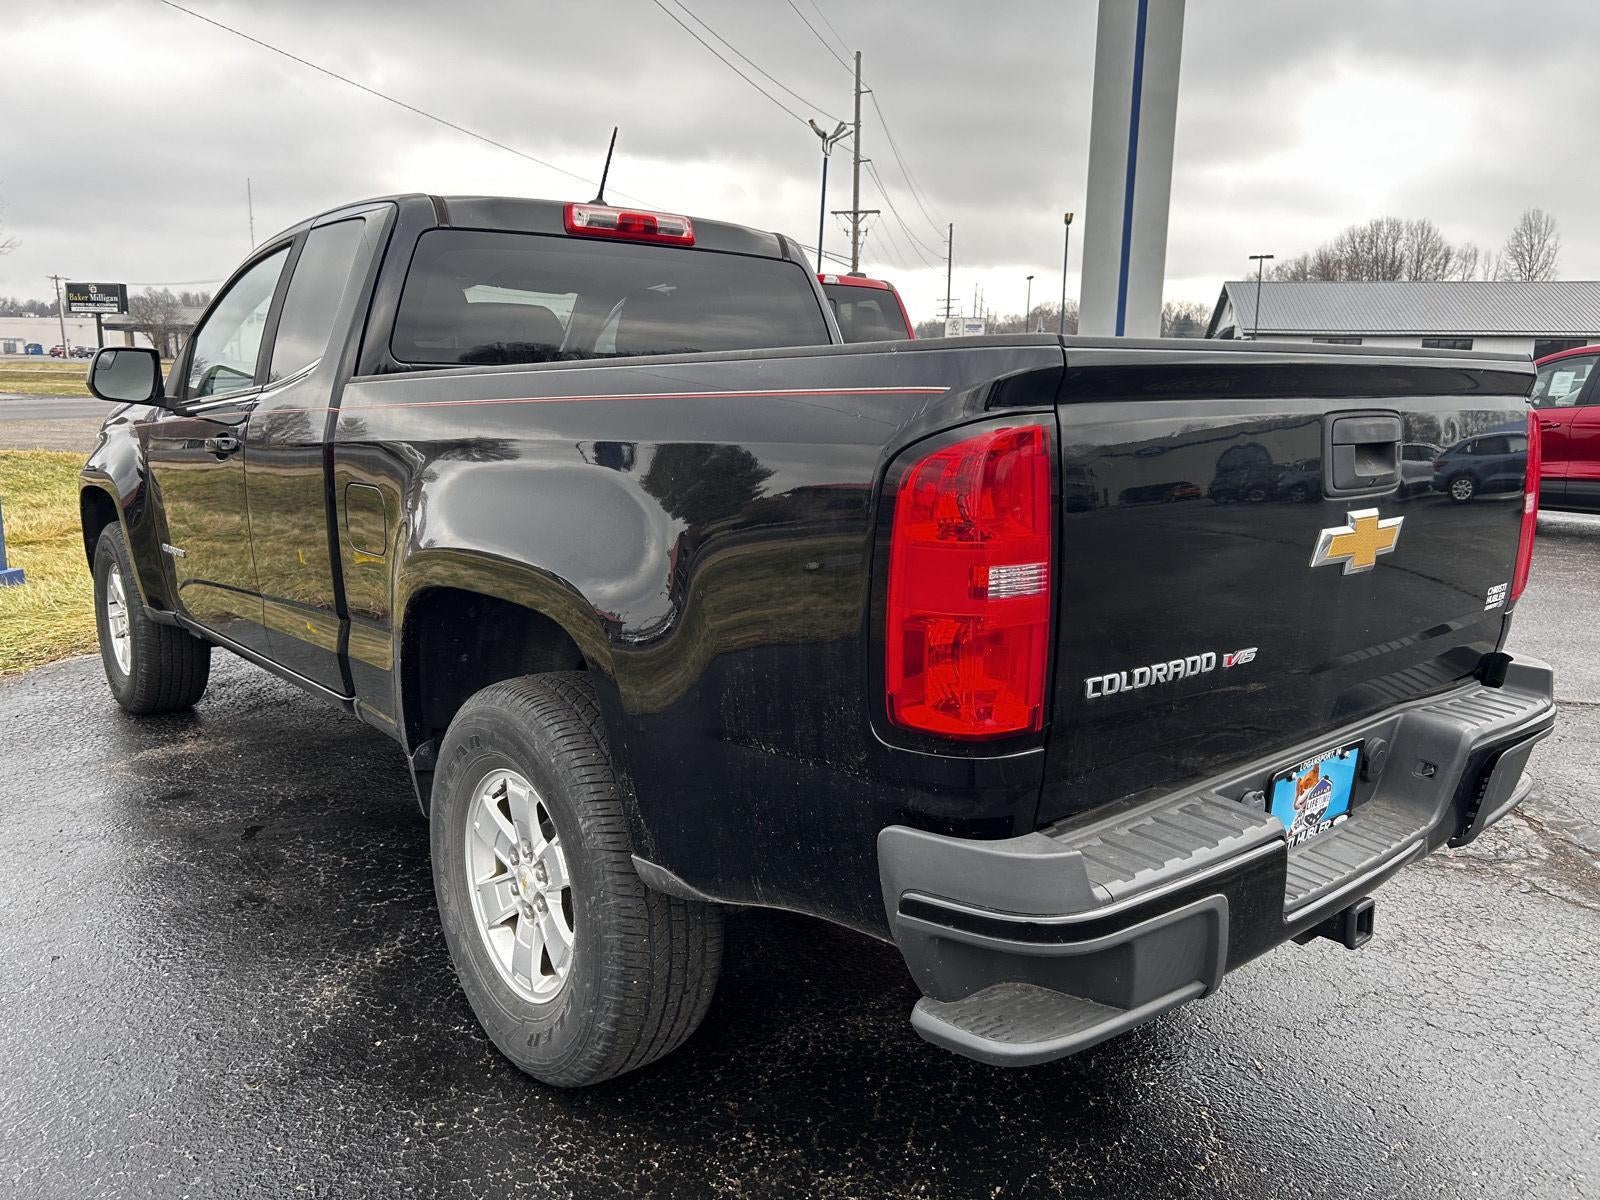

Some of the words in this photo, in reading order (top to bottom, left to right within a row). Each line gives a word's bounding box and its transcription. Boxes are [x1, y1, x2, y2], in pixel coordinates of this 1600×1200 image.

[69, 293, 88, 301] Baker
[89, 293, 118, 303] Milligan
[1084, 651, 1216, 699] COLORADO
[1222, 647, 1258, 668] V6
[1297, 819, 1332, 845] HUBLER
